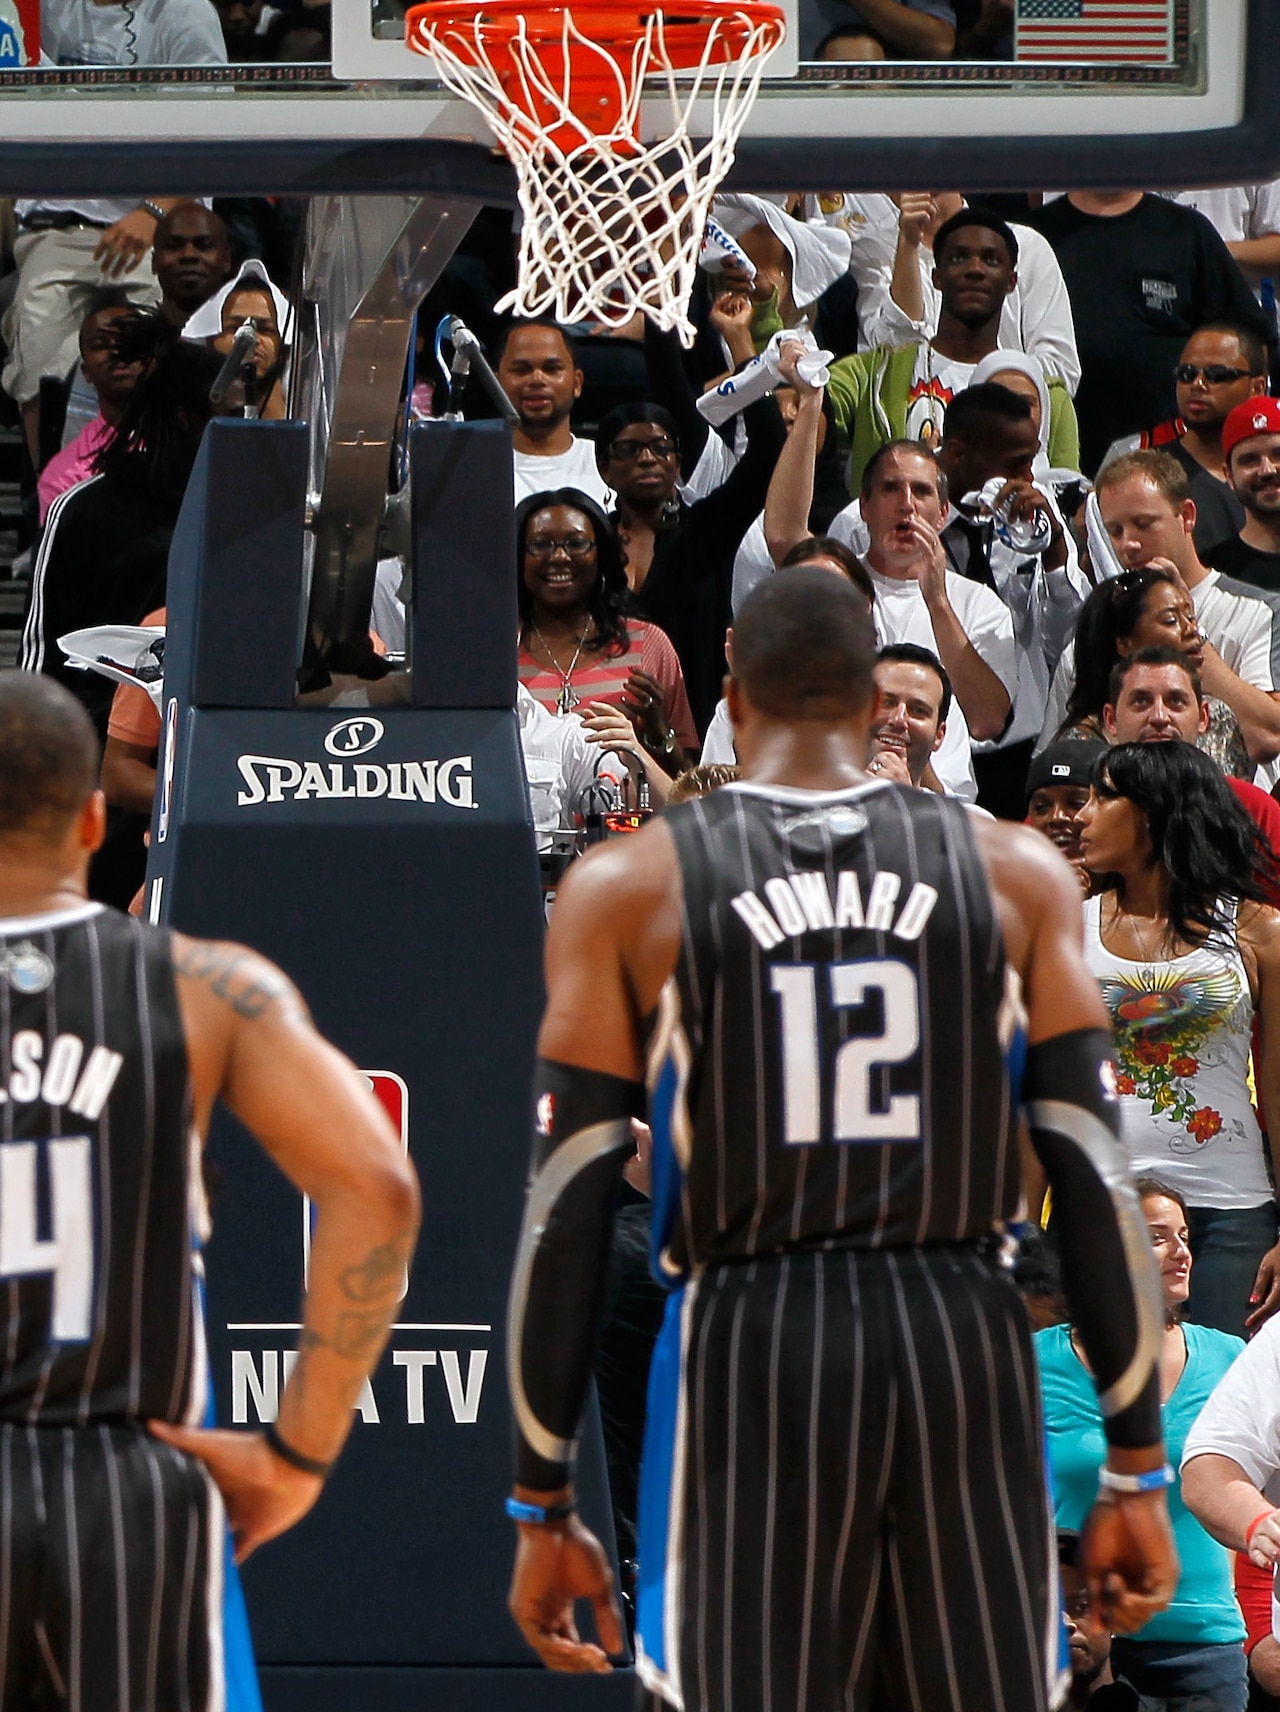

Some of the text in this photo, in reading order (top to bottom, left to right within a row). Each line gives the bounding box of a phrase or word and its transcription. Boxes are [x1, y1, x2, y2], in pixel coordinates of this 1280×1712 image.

[237, 754, 477, 809] SPALDING
[730, 868, 939, 950] HOWARD
[769, 958, 921, 1145] 12
[392, 1350, 488, 1424] TV
